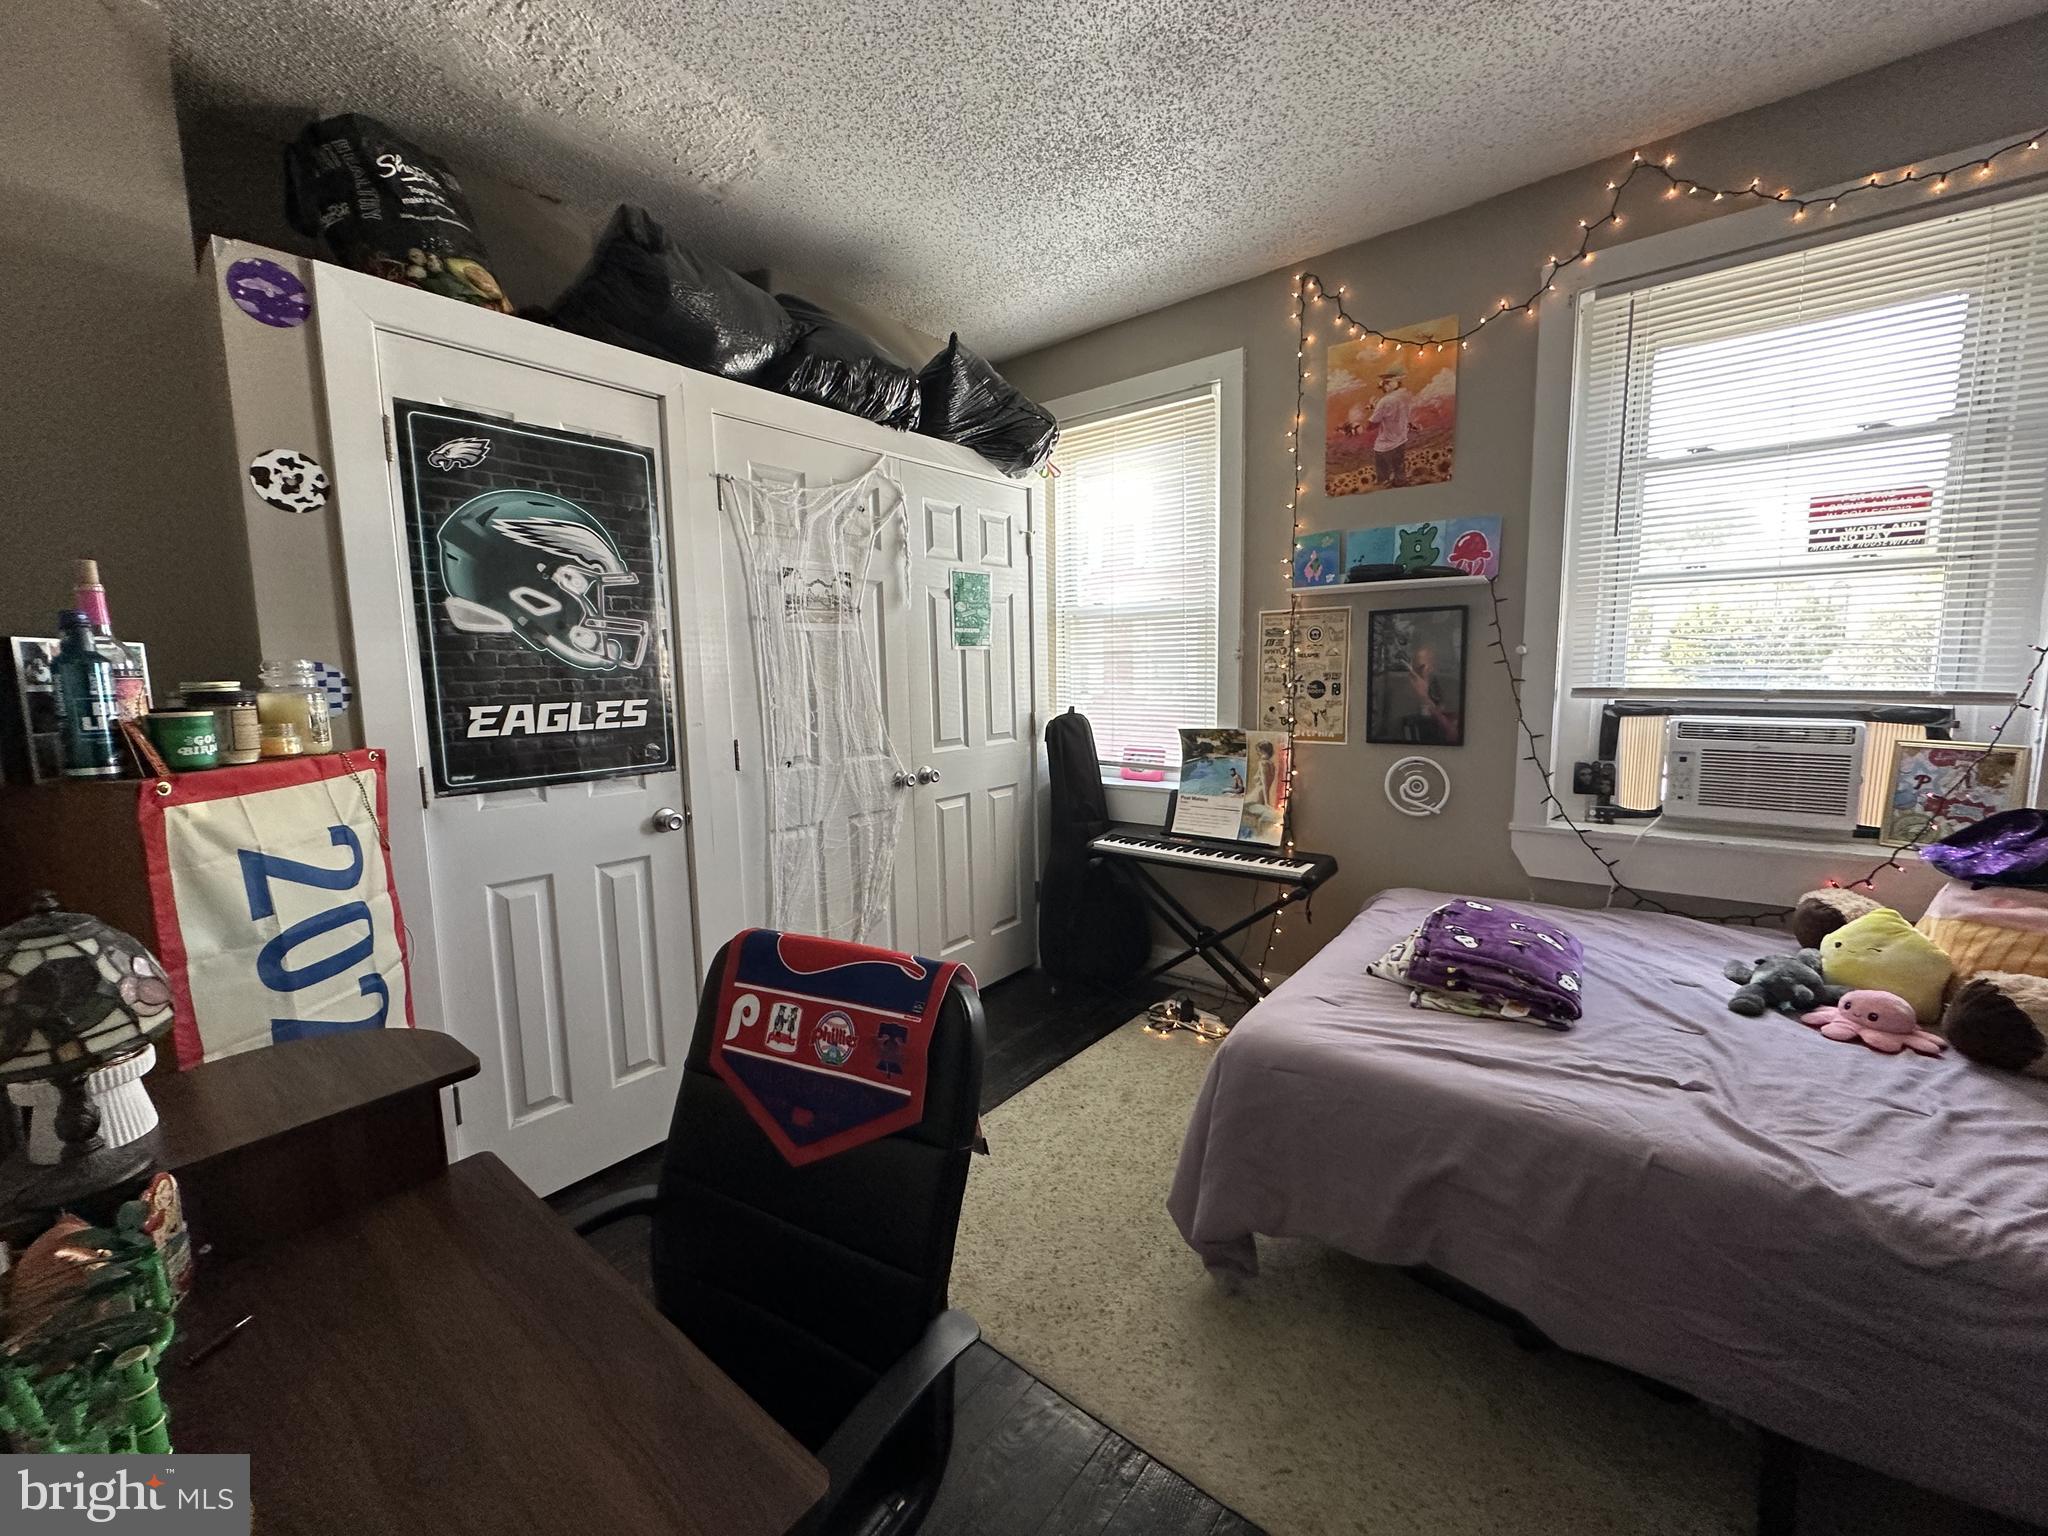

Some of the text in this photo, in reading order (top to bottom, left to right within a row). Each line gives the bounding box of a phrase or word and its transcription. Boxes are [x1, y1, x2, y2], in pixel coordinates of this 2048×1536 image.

[1844, 524, 1884, 533] WORK
[1891, 521, 1921, 529] AND
[1840, 530, 1891, 541] NO PAY
[467, 699, 649, 739] EAGLES
